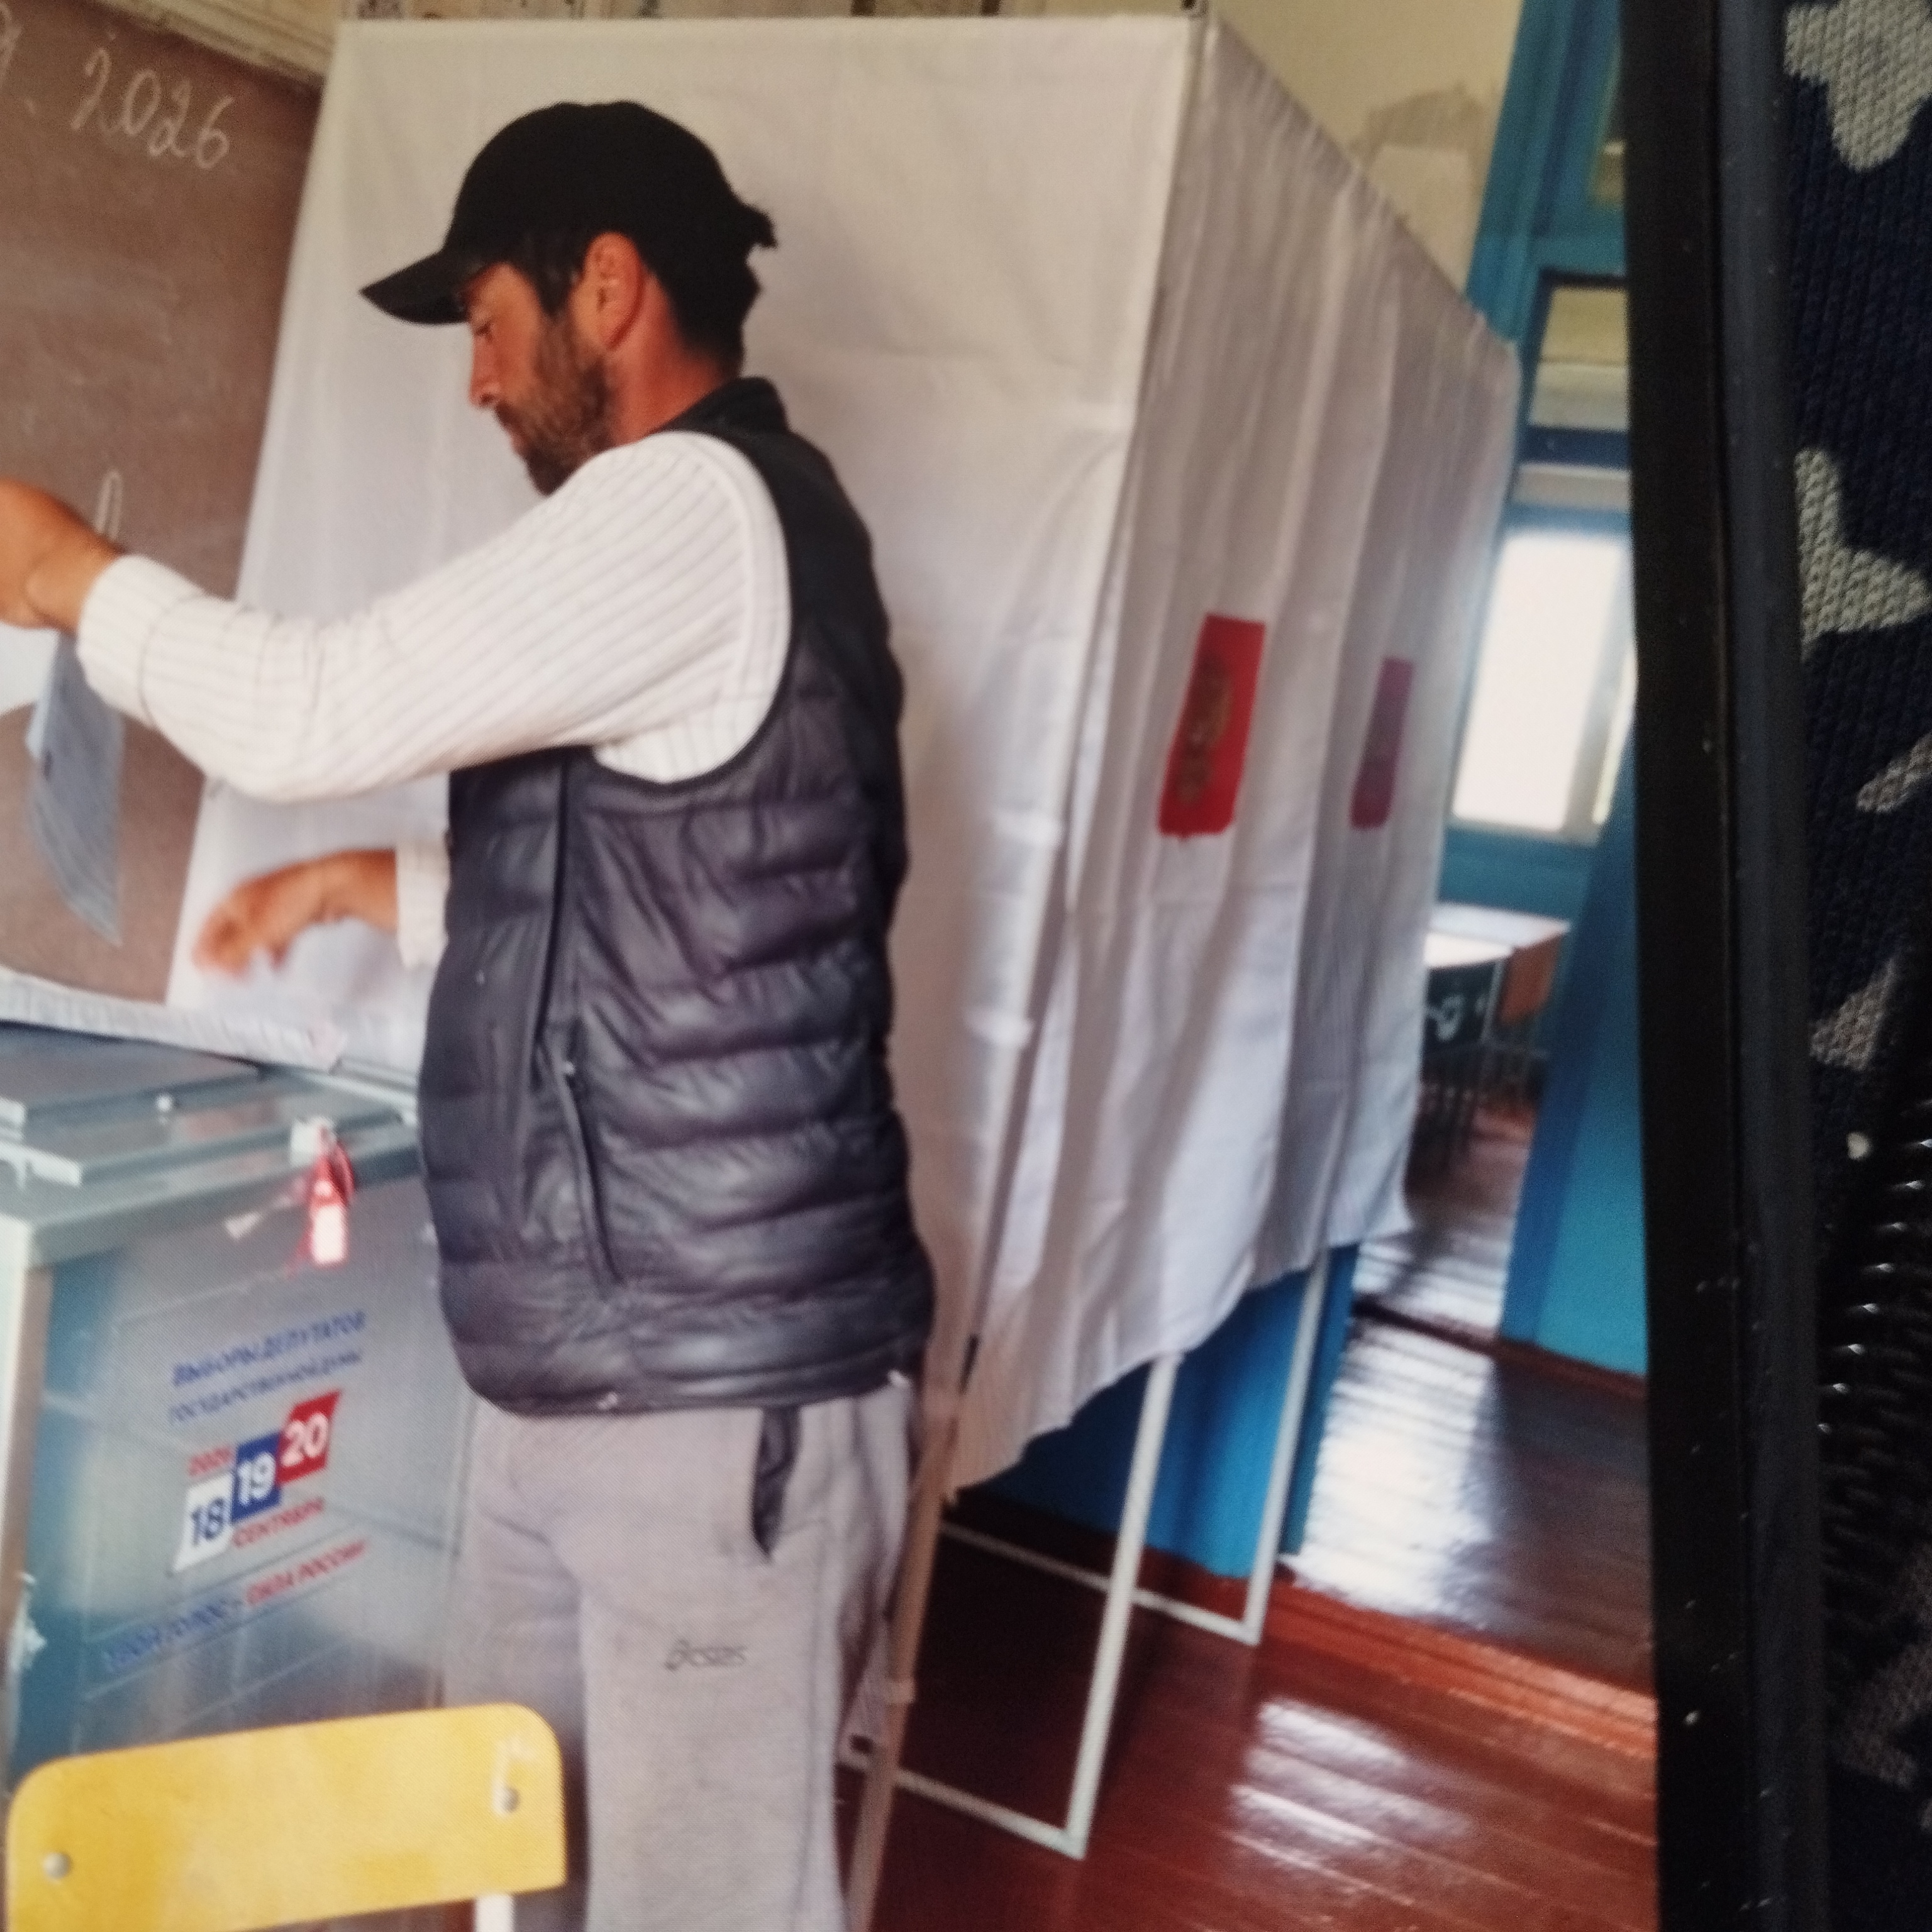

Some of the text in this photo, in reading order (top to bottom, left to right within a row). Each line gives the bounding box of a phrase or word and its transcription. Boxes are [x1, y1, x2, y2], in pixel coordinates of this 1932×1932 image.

[70, 47, 235, 170] 2026
[280, 1413, 330, 1467] 20
[236, 1452, 276, 1505] 19
[190, 1497, 225, 1547] 18
